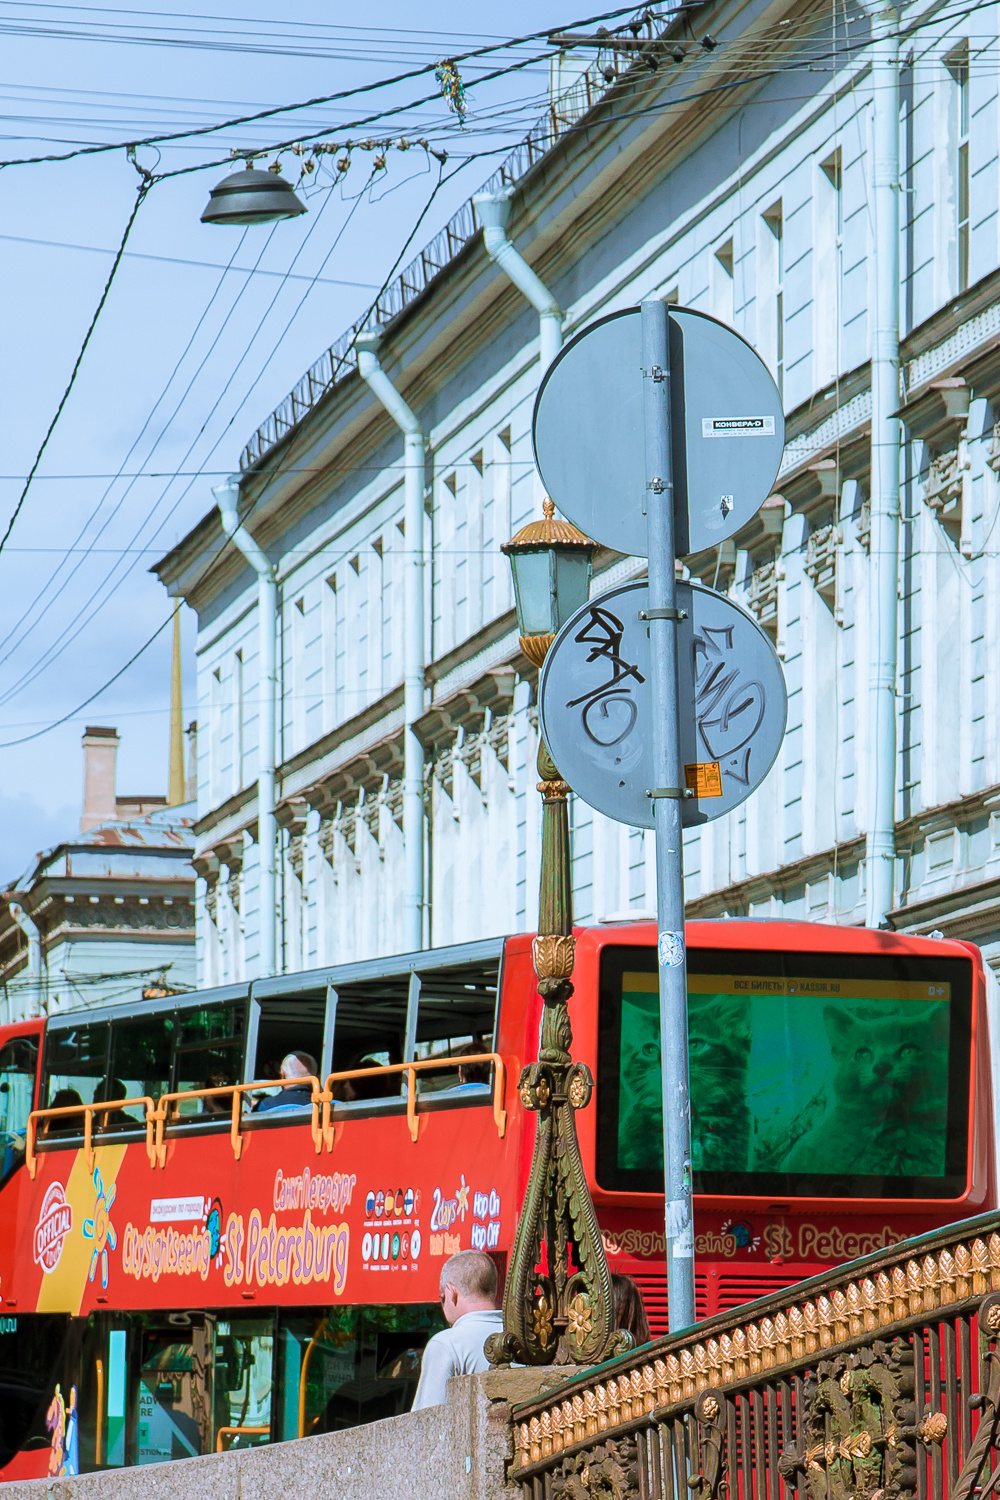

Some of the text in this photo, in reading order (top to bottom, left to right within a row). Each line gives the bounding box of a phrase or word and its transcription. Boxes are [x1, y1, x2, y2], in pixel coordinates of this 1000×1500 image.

[733, 980, 785, 991] ВСЕ БИЛЕТЫ
[473, 1188, 500, 1221] Hop On
[37, 1208, 71, 1254] OFFICIAL
[471, 1220, 500, 1252] Hop Off
[763, 1224, 795, 1258] St
[224, 1208, 350, 1296] St Petersburg
